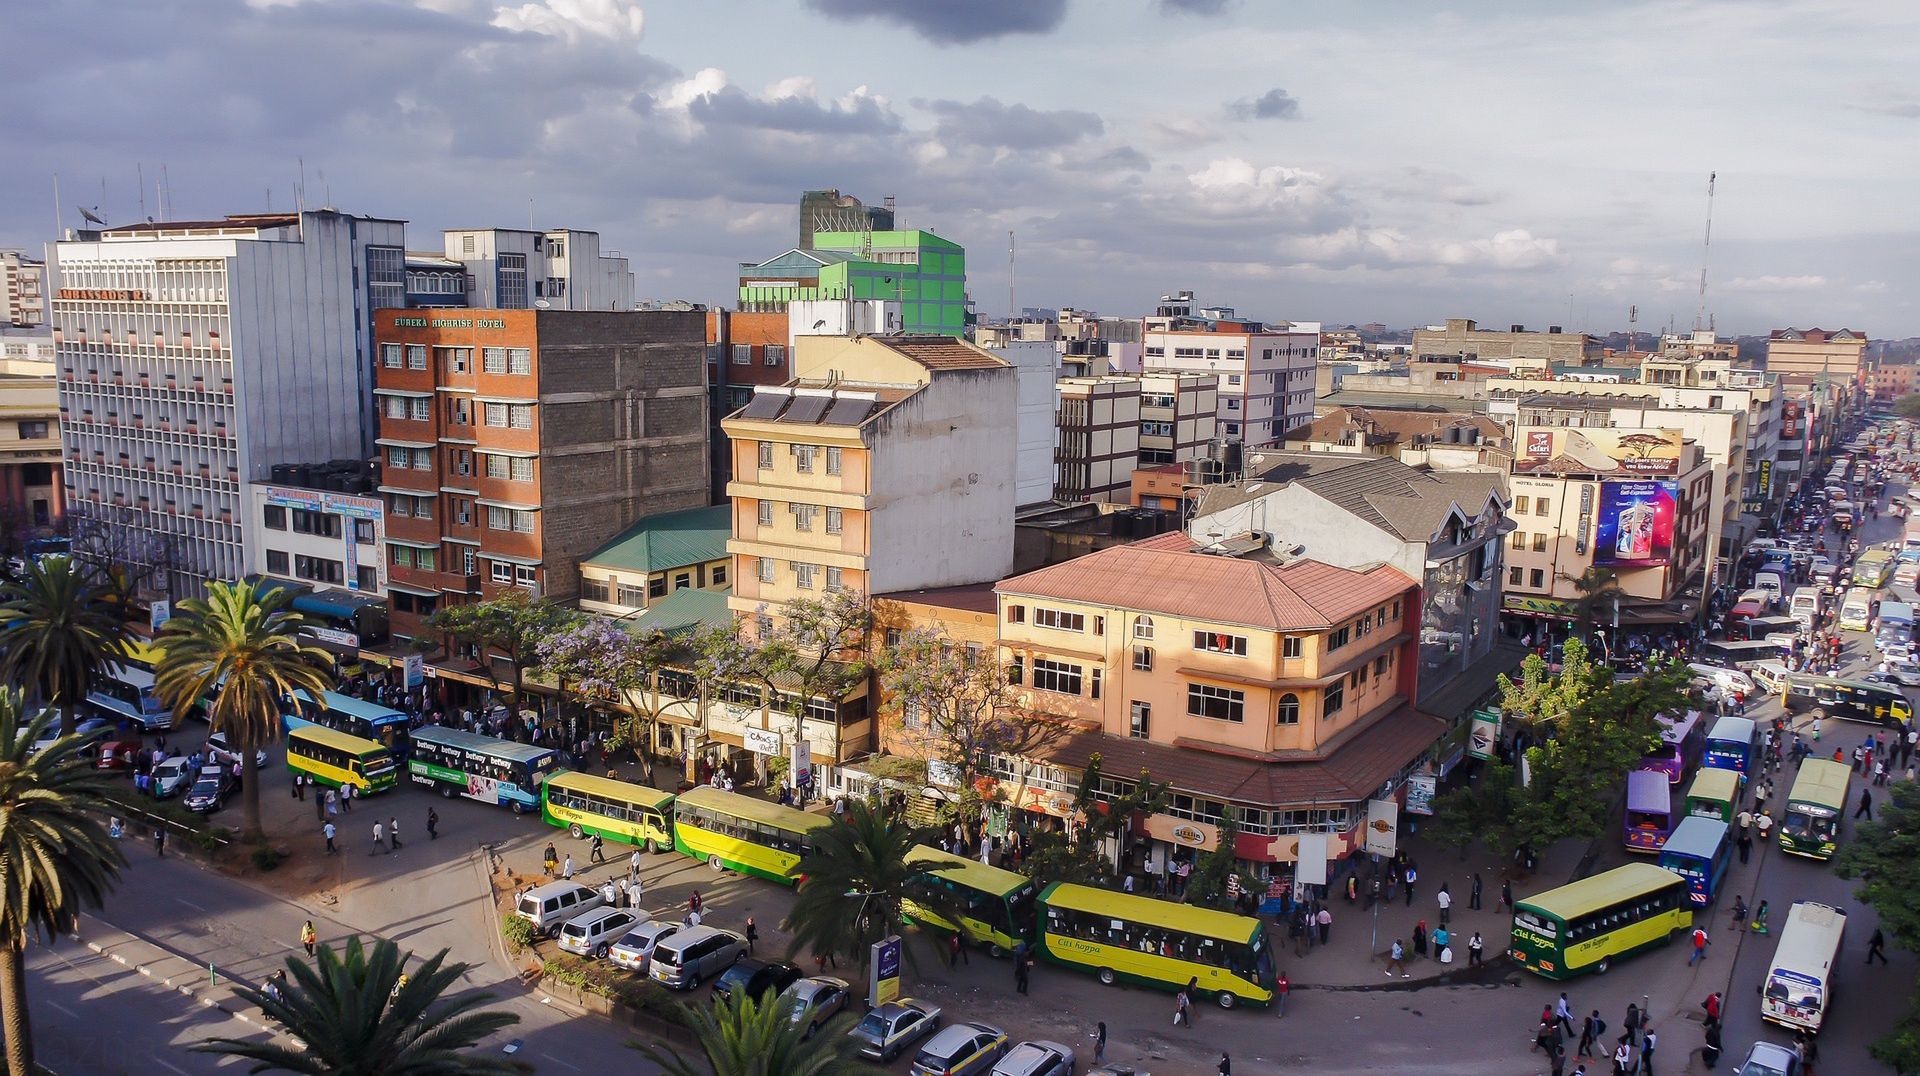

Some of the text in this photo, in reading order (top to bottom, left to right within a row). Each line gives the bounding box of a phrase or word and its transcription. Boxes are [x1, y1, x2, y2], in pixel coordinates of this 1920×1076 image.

[55, 288, 143, 300] AMBASSADER
[394, 318, 506, 329] EUREKA HIGHRISE HOTEL
[416, 740, 437, 753] betway
[441, 745, 461, 758] betway
[465, 751, 486, 764] betway
[490, 756, 511, 770] betway
[411, 773, 436, 788] betway
[1057, 938, 1100, 954] Citi hoppa
[1530, 933, 1555, 949] hoppa
